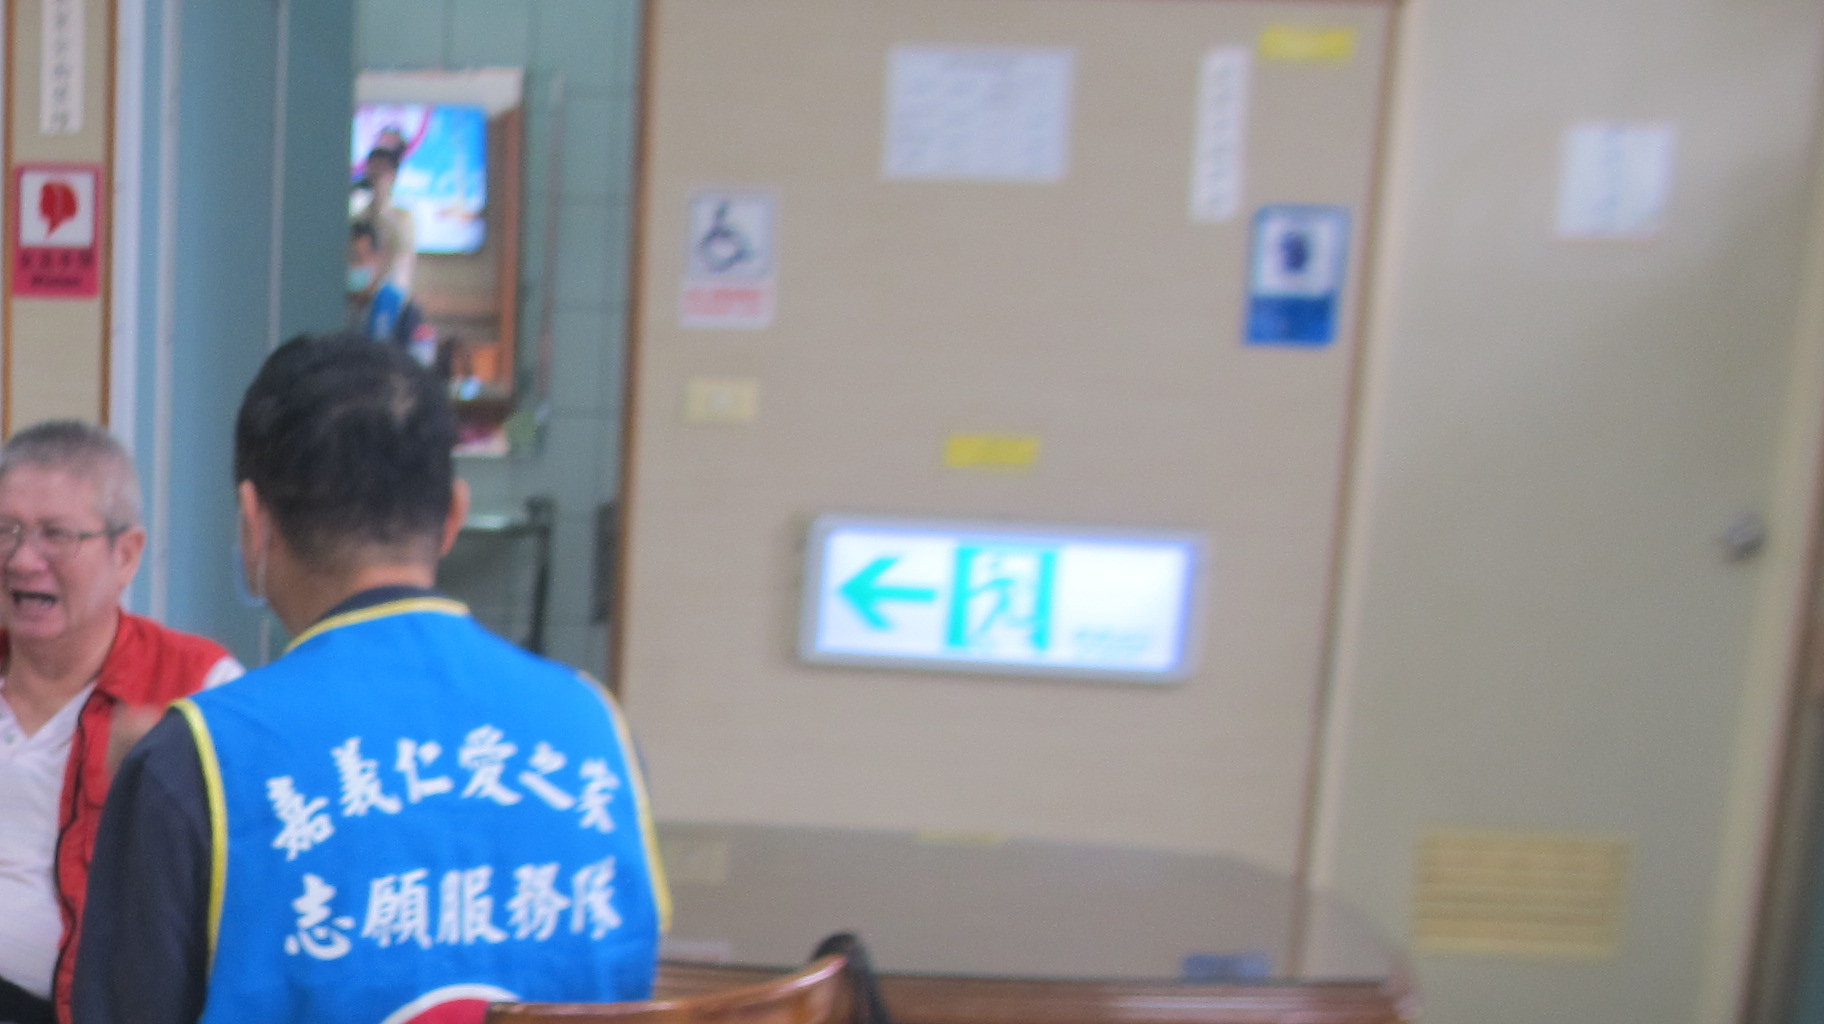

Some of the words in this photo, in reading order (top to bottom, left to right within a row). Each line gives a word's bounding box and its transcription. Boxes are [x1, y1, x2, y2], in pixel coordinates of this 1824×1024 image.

[284, 855, 623, 960] 志願服務隊
